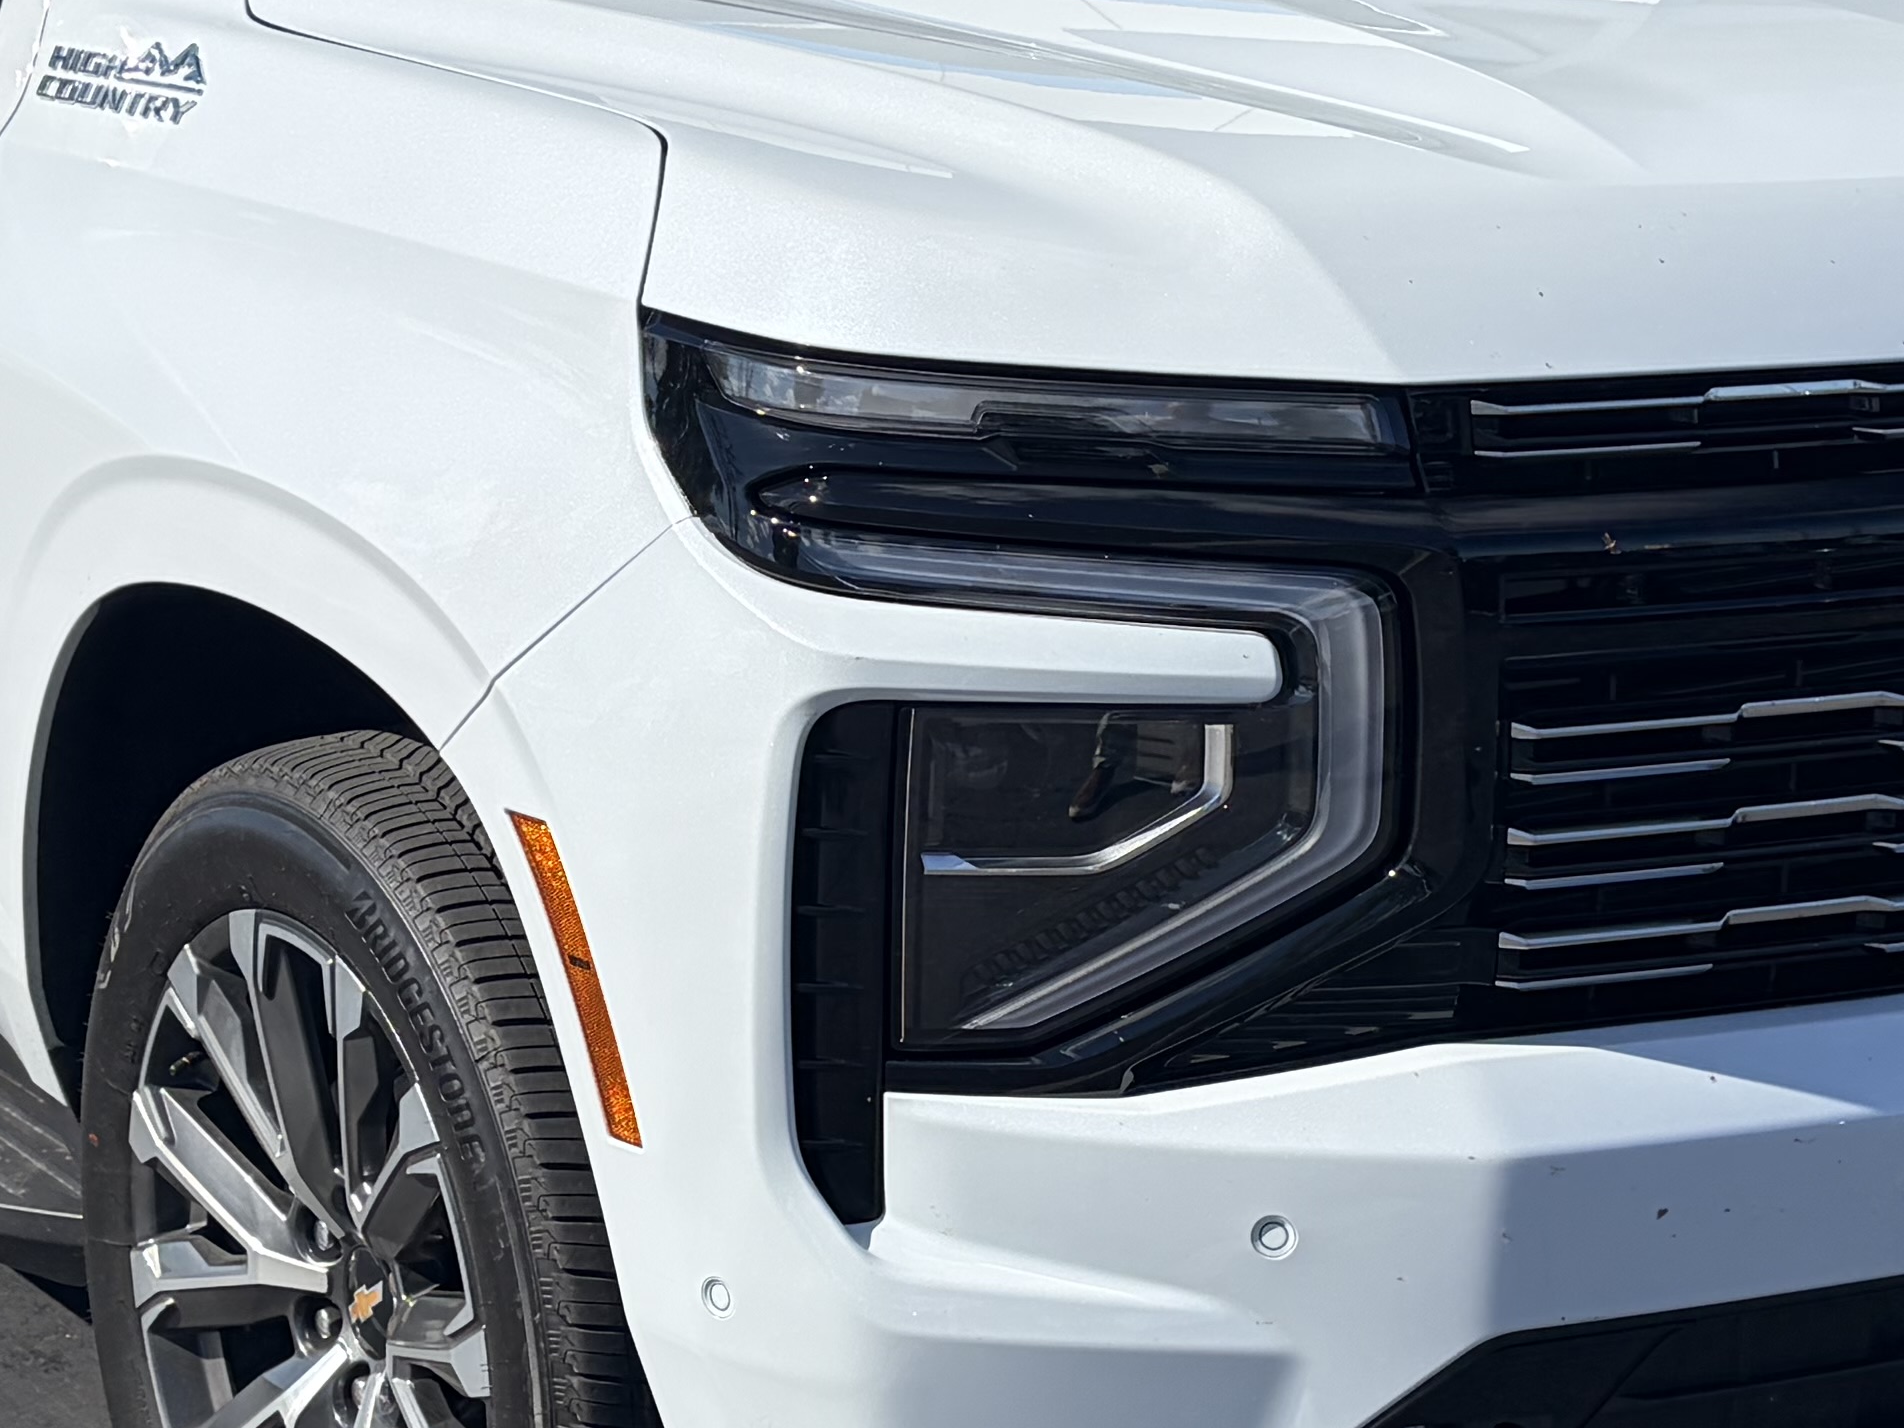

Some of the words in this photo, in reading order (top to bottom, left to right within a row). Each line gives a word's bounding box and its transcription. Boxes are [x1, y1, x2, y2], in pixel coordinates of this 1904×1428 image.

[49, 45, 124, 78] HIGH
[36, 75, 197, 124] COUNTRY
[346, 890, 487, 1164] BRIDGESTONE
